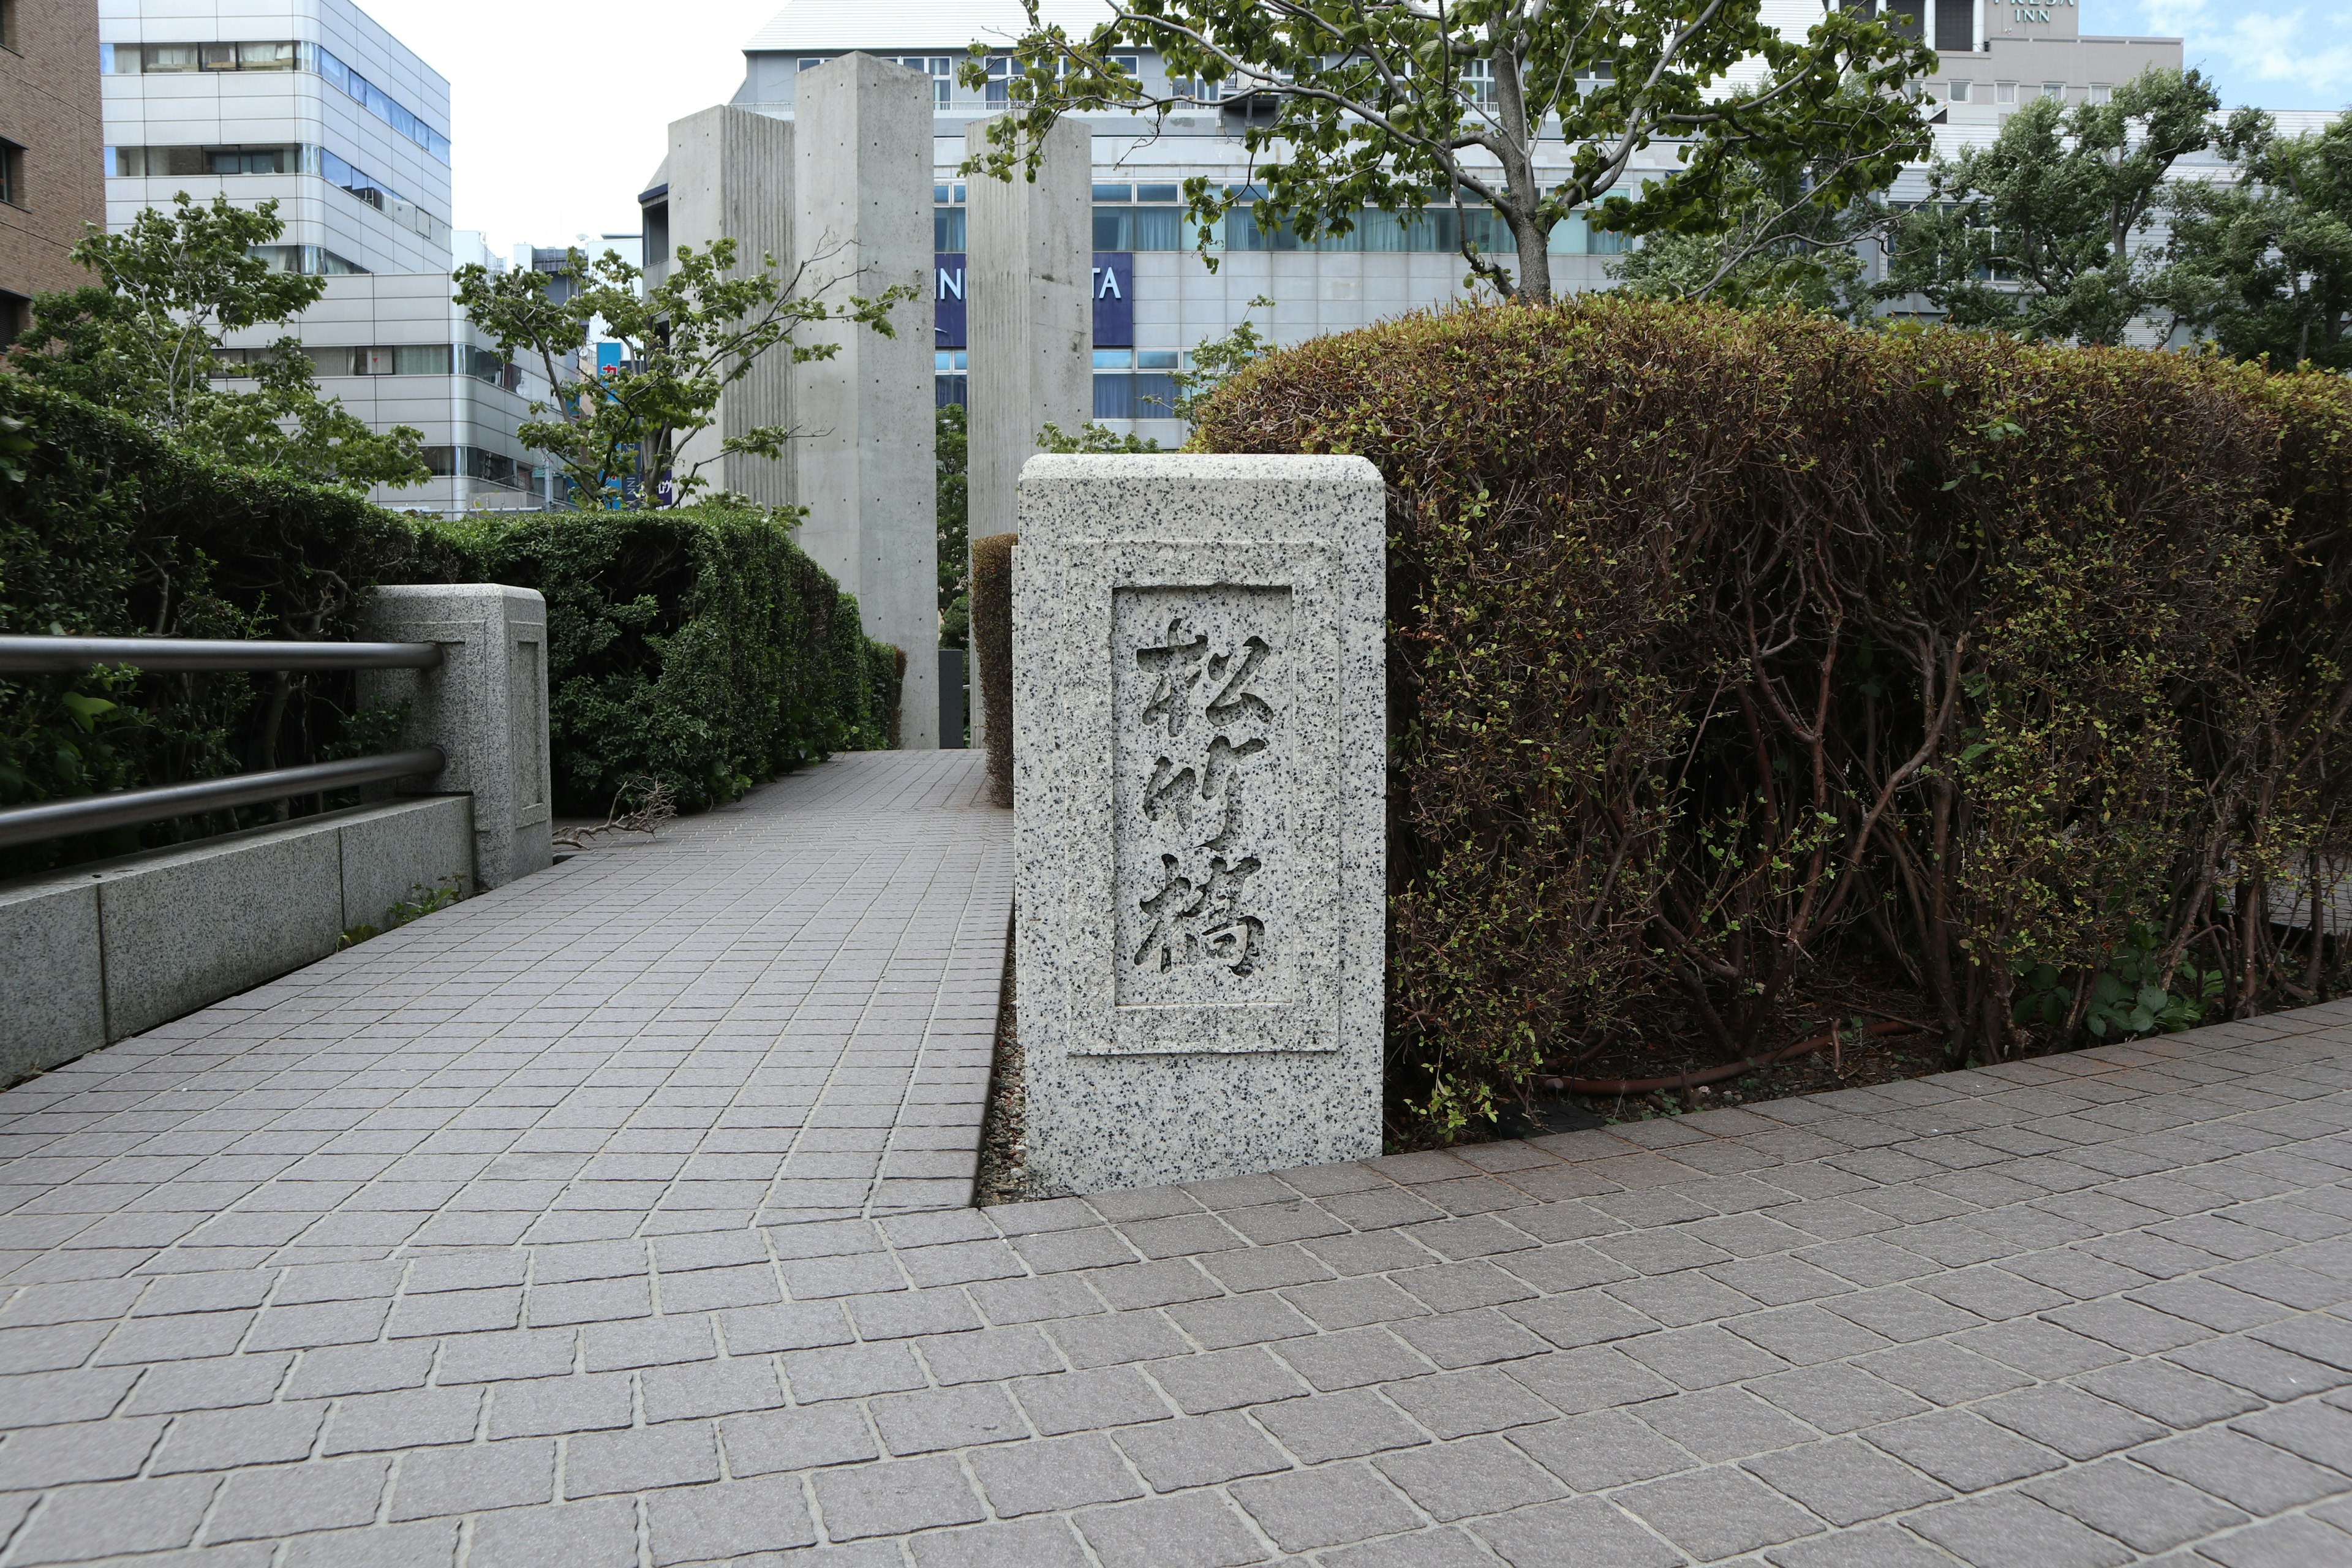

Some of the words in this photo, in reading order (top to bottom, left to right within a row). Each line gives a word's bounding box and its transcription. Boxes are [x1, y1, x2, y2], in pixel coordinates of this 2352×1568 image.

[2015, 9, 2051, 23] INN
[1134, 617, 1275, 979] 松竹橋
